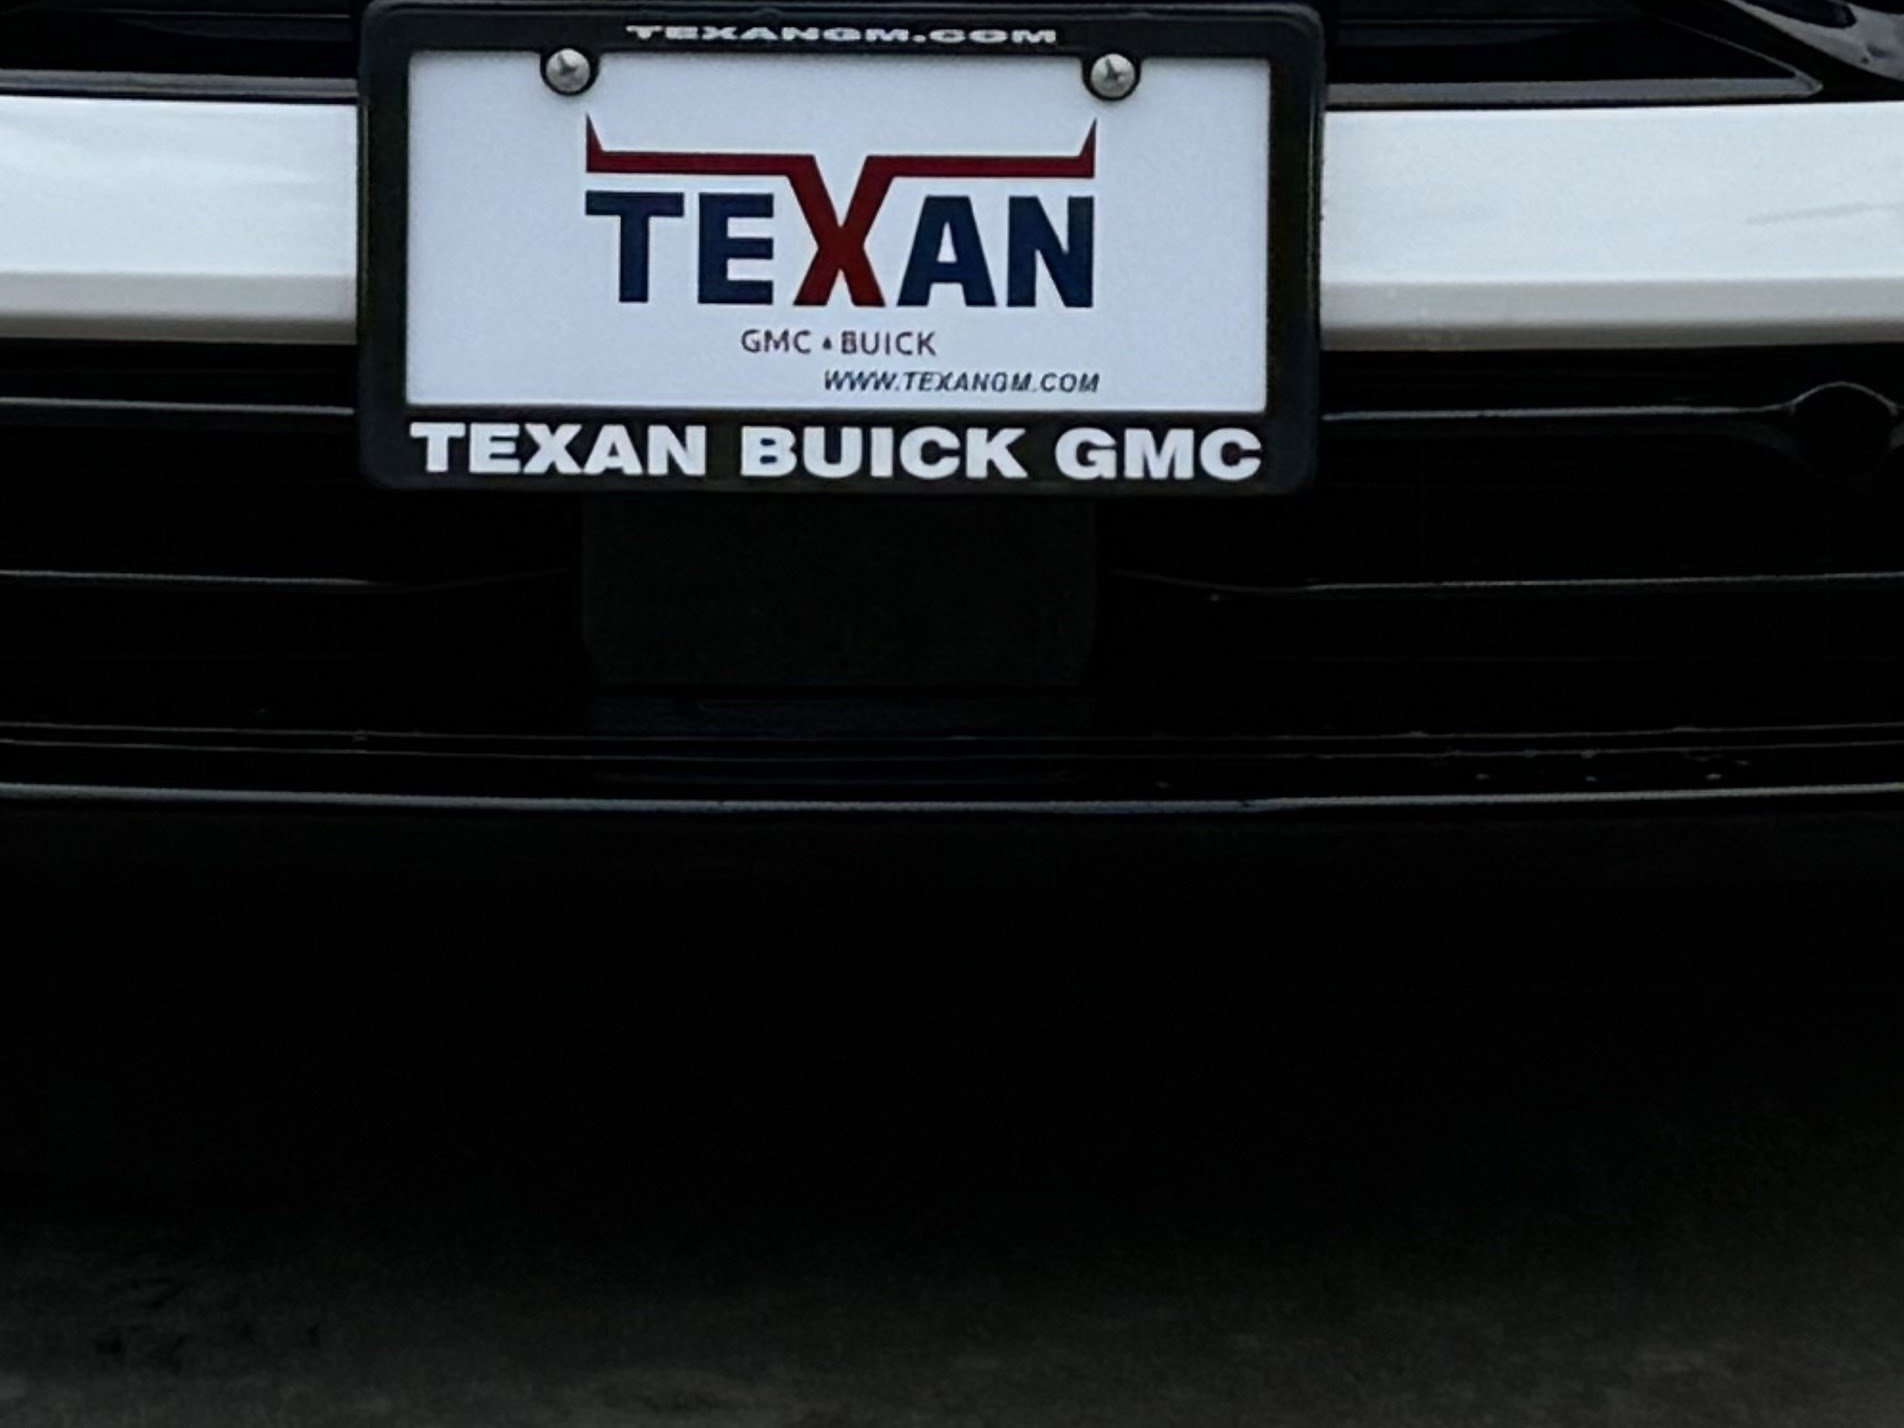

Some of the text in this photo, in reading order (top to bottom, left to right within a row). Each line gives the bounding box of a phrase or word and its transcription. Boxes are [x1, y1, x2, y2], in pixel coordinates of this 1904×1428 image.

[625, 24, 1058, 44] TEXANGM.COM
[584, 152, 1097, 309] TEXAN
[740, 327, 938, 357] GMC BUICK
[823, 369, 1101, 394] WWW.TEXANGM.COM
[409, 421, 1263, 482] TEXAN BUICK GMC
